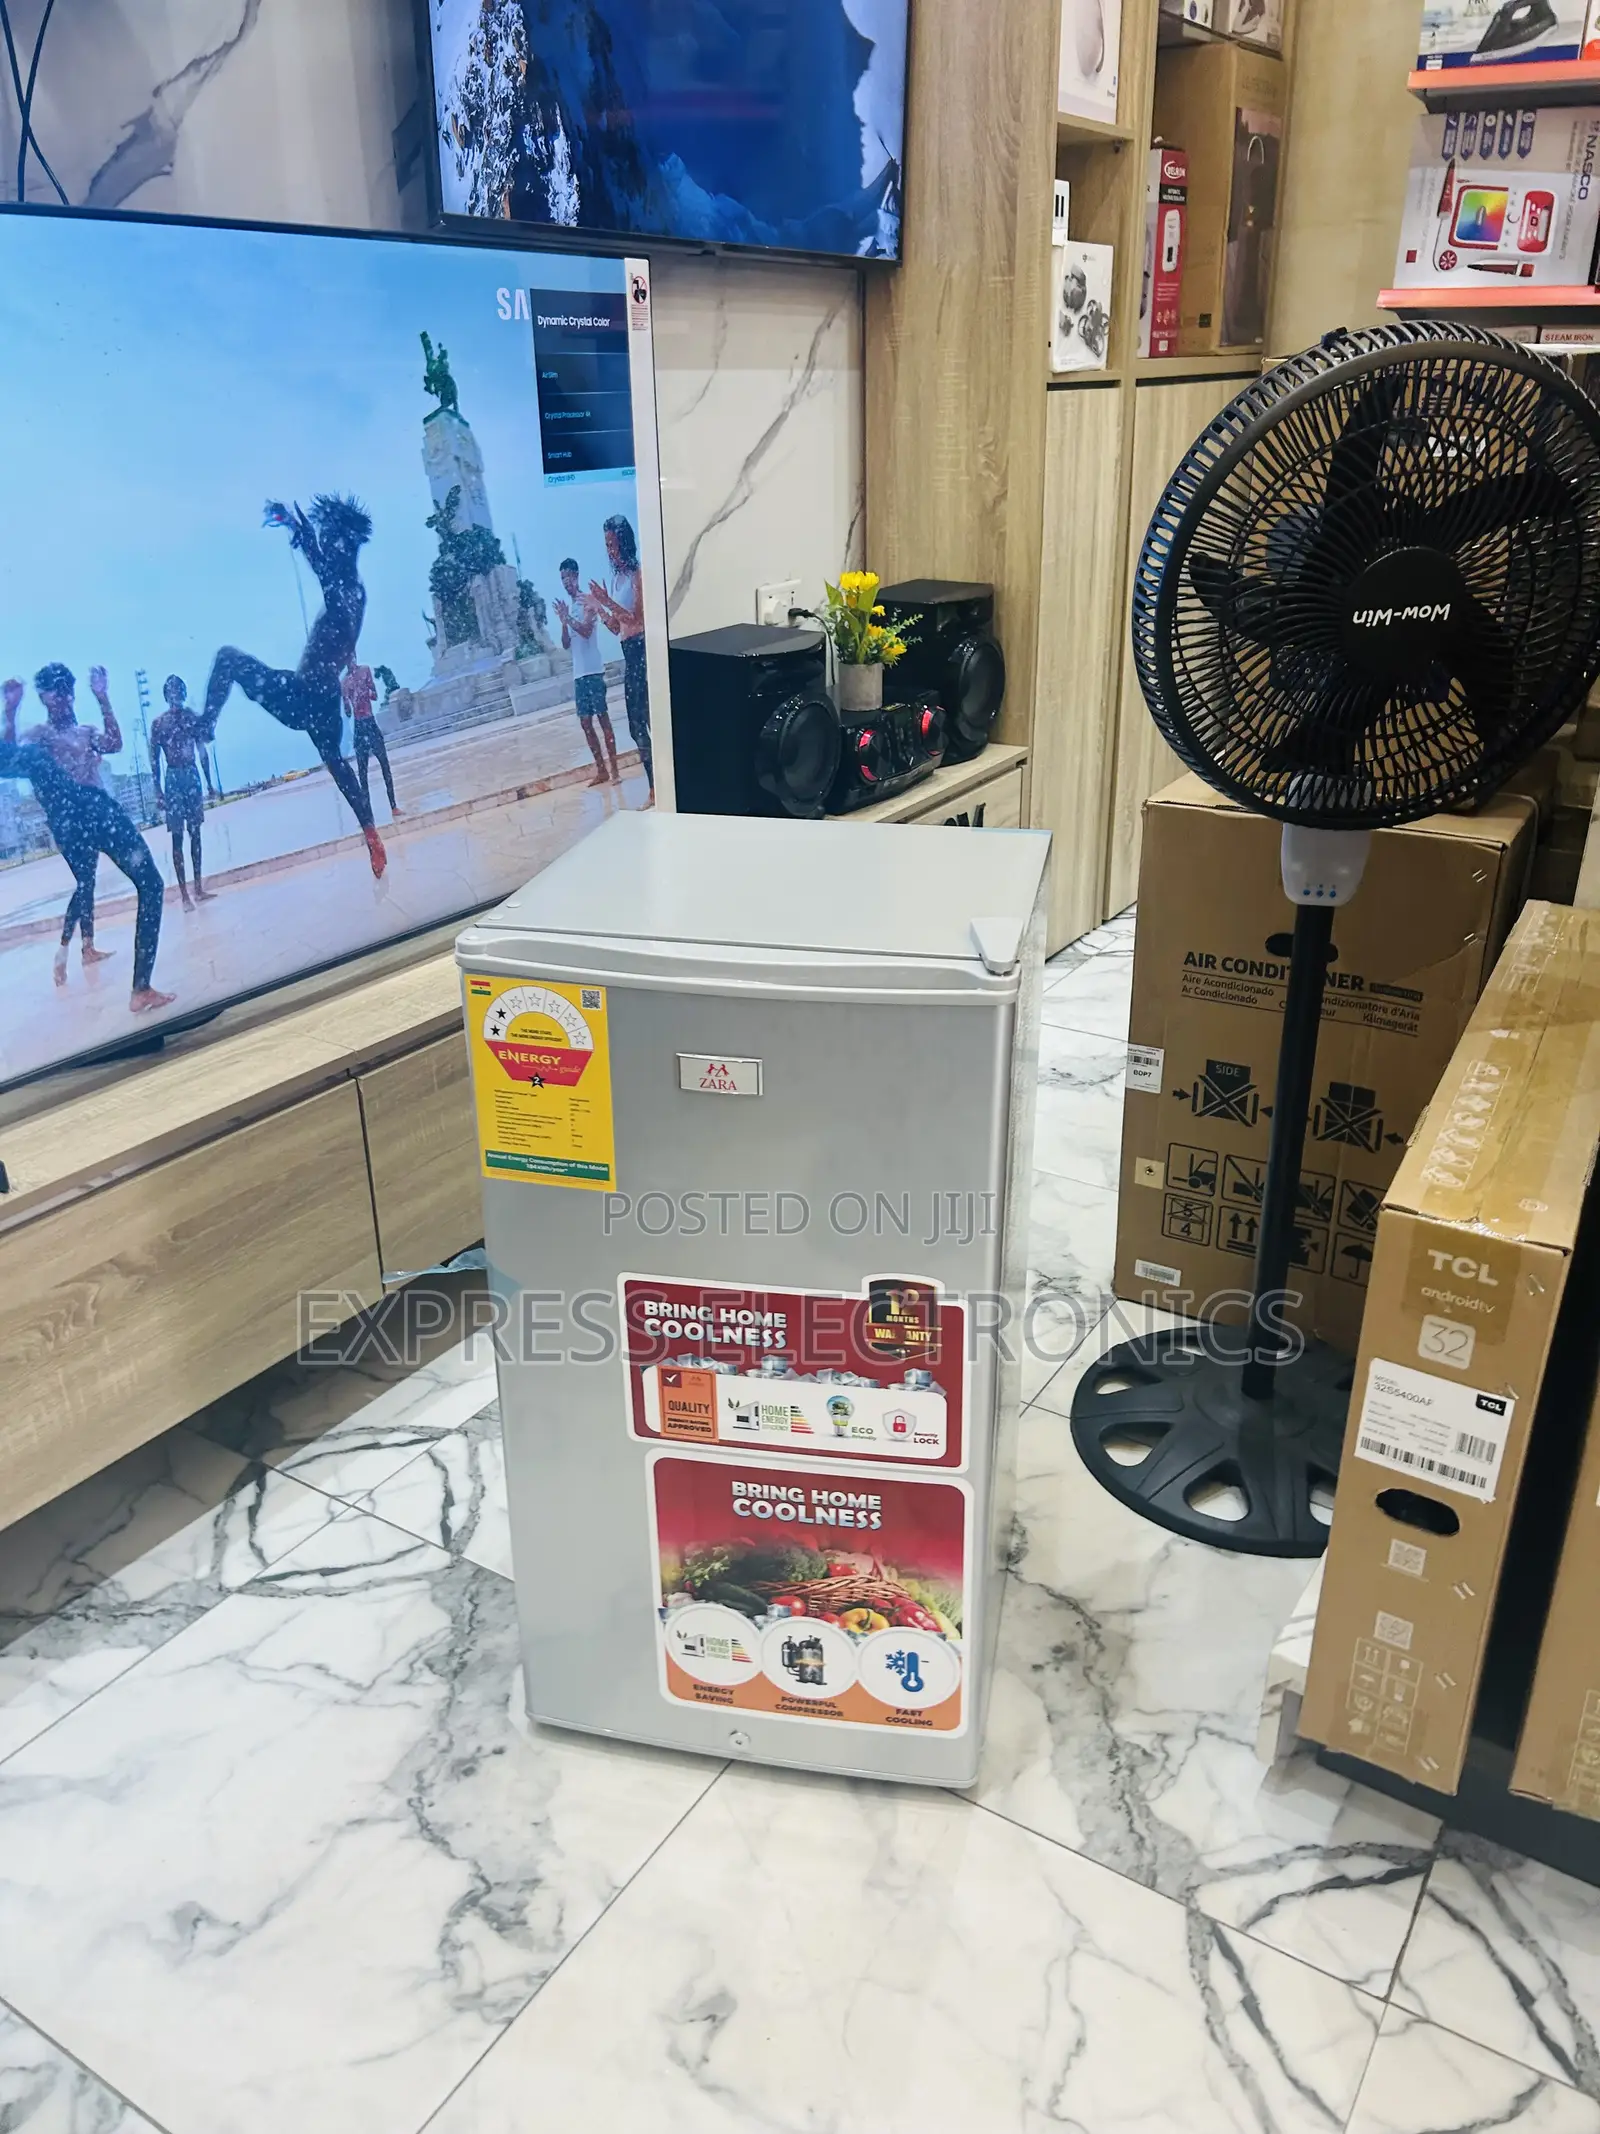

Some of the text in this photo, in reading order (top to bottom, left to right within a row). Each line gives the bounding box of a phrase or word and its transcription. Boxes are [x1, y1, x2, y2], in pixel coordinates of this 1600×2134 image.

[1577, 135, 1598, 201] NASCO
[537, 315, 610, 329] Dynamic Crystal Color
[1544, 333, 1594, 341] STEAM IRON
[1183, 951, 1364, 991] AIR CONDINER
[1182, 973, 1275, 996] Aire Acondicionado
[1181, 985, 1258, 1004] Ar Condicionado
[498, 1048, 562, 1066] ENERGY
[1215, 1063, 1241, 1077] SIDE
[533, 1076, 540, 1084] 2
[699, 1077, 738, 1091] ZARA
[508, 1154, 528, 1163] Energy
[529, 1157, 568, 1168] Consumption
[1427, 1248, 1498, 1287] TCL
[643, 1300, 788, 1329] BRING HOME
[885, 1314, 919, 1324] MONTHS
[643, 1318, 788, 1350] COOLNESS
[1423, 1321, 1469, 1362] 32
[668, 1400, 710, 1414] QUALITY
[761, 1405, 789, 1417] HOME
[1479, 1399, 1503, 1412] TCL
[761, 1415, 789, 1425] ENERGY
[667, 1422, 712, 1433] APPROVED
[851, 1426, 874, 1434] ECO
[913, 1437, 940, 1445] LOCK
[731, 1481, 882, 1511] BRING HOME
[732, 1498, 882, 1530] COOLNESS
[693, 1684, 734, 1695] ENERGY
[695, 1693, 734, 1704] SAVING
[781, 1696, 837, 1709] POWERFUL
[775, 1703, 844, 1717] COMPRESSOR
[895, 1708, 923, 1717] FAST
[885, 1716, 933, 1726] COOLING
